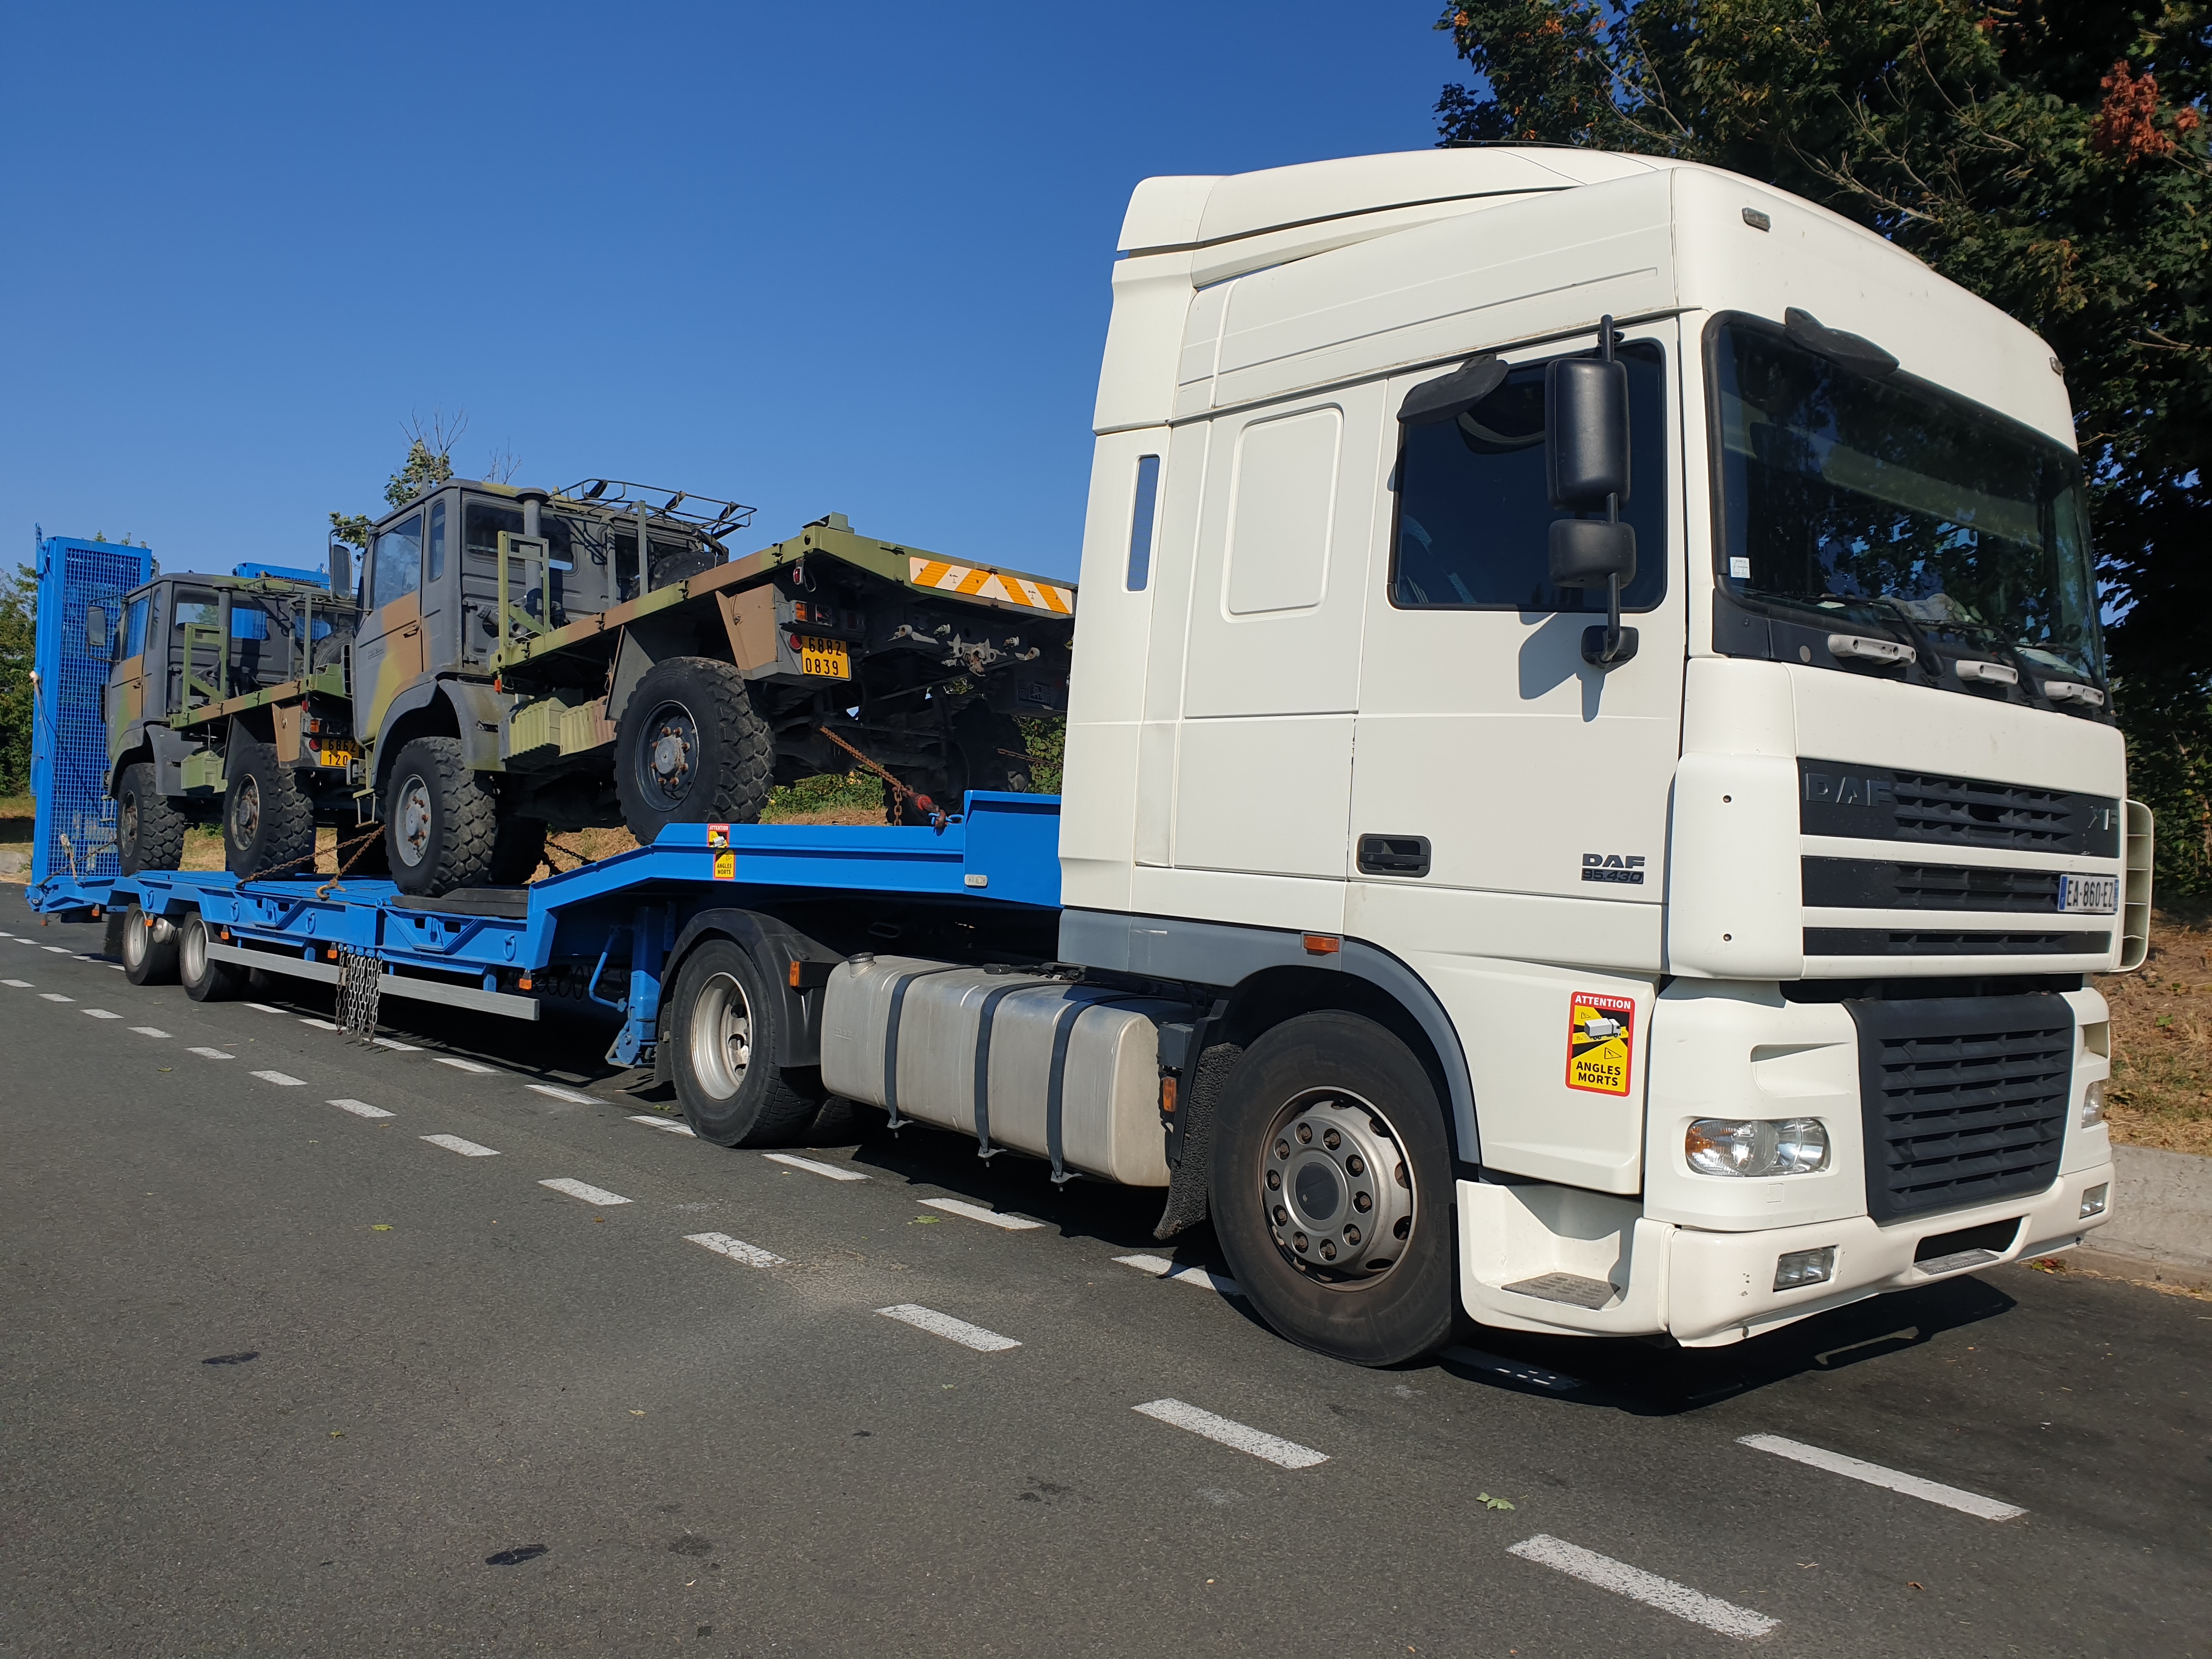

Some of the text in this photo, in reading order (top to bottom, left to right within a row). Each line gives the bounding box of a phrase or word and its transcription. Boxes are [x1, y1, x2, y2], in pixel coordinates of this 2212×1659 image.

[809, 637, 842, 656] 6882
[805, 657, 839, 676] 0839
[328, 739, 356, 753] 6862
[1805, 772, 1892, 808] DAF
[1582, 853, 1645, 868] DAF
[1582, 868, 1643, 883] 95.430
[2067, 880, 2113, 907] EA-860-EZ
[1575, 995, 1631, 1009] ATTENTION
[1576, 1061, 1621, 1076] ANGLES
[1578, 1071, 1618, 1087] MORTS
